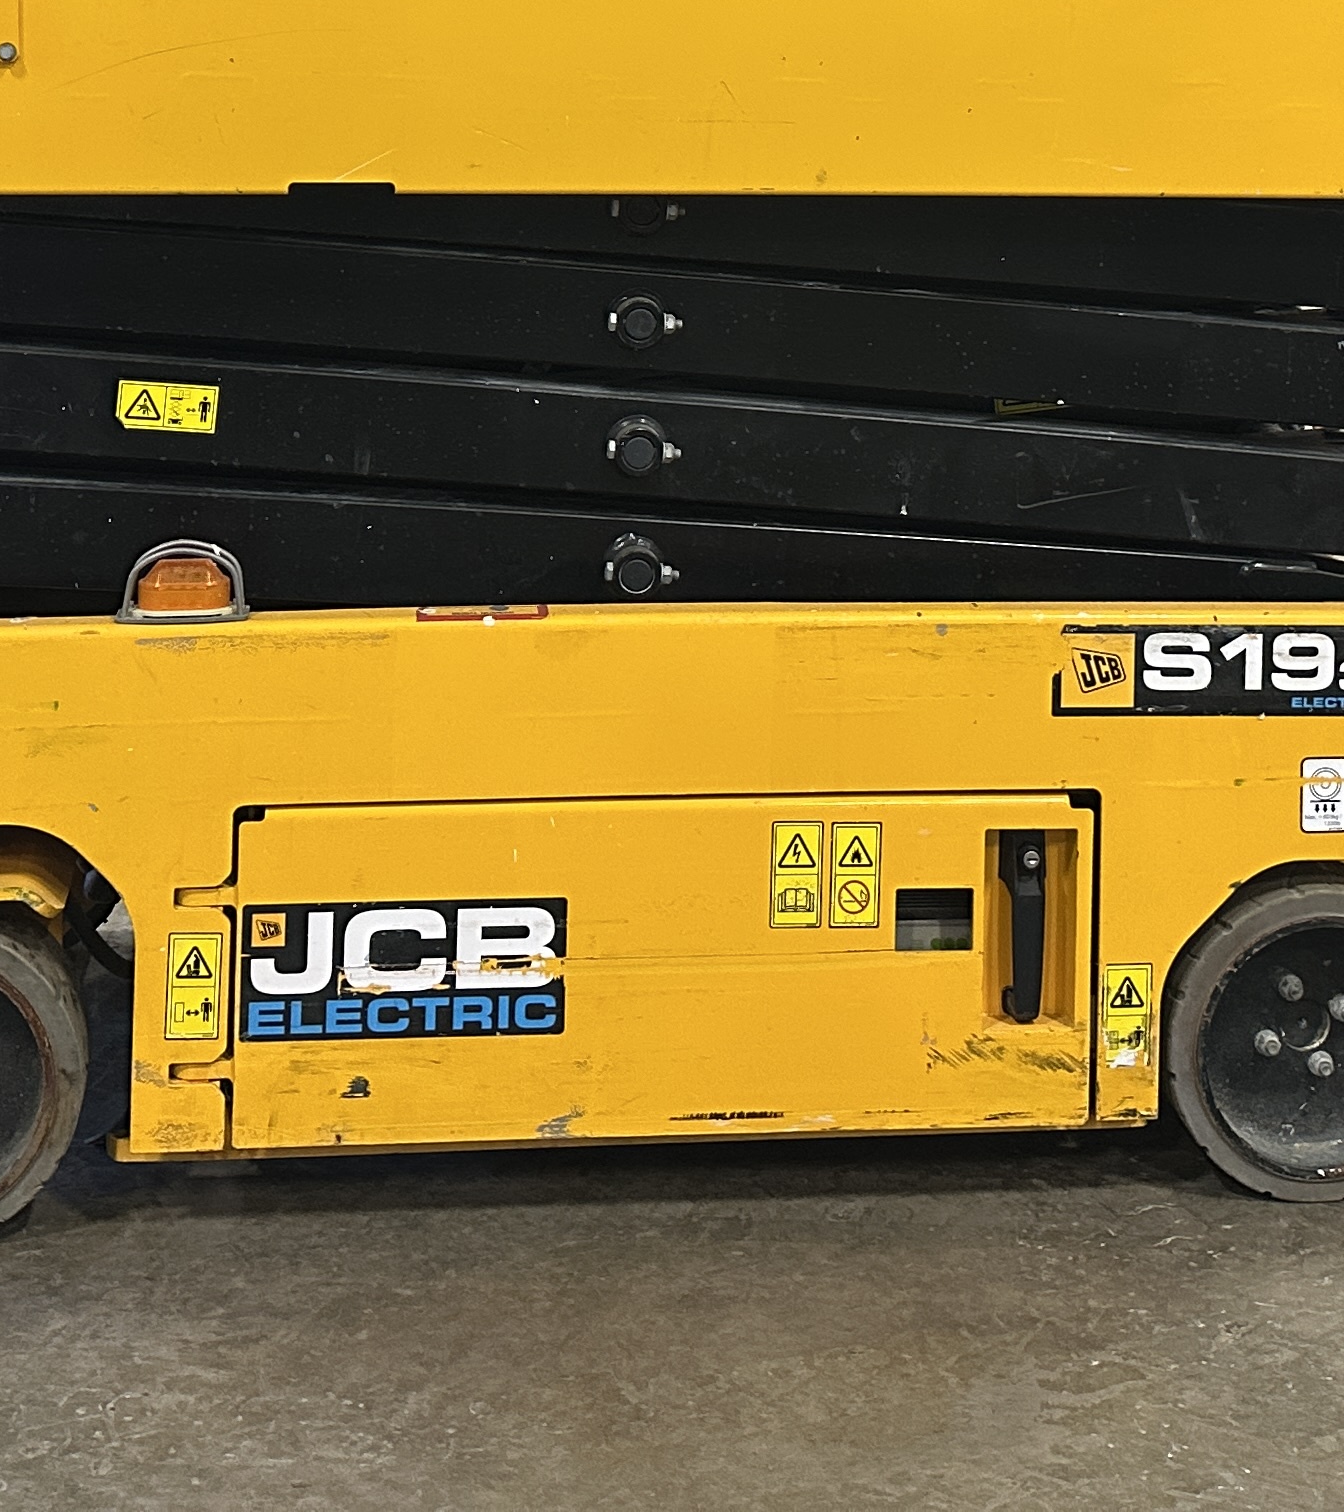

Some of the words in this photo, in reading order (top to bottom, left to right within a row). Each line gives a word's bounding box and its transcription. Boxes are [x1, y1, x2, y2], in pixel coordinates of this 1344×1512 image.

[1080, 652, 1123, 689] JCB
[260, 921, 281, 938] JCB
[250, 906, 557, 995] JCB
[246, 995, 557, 1037] ELECTRIC
